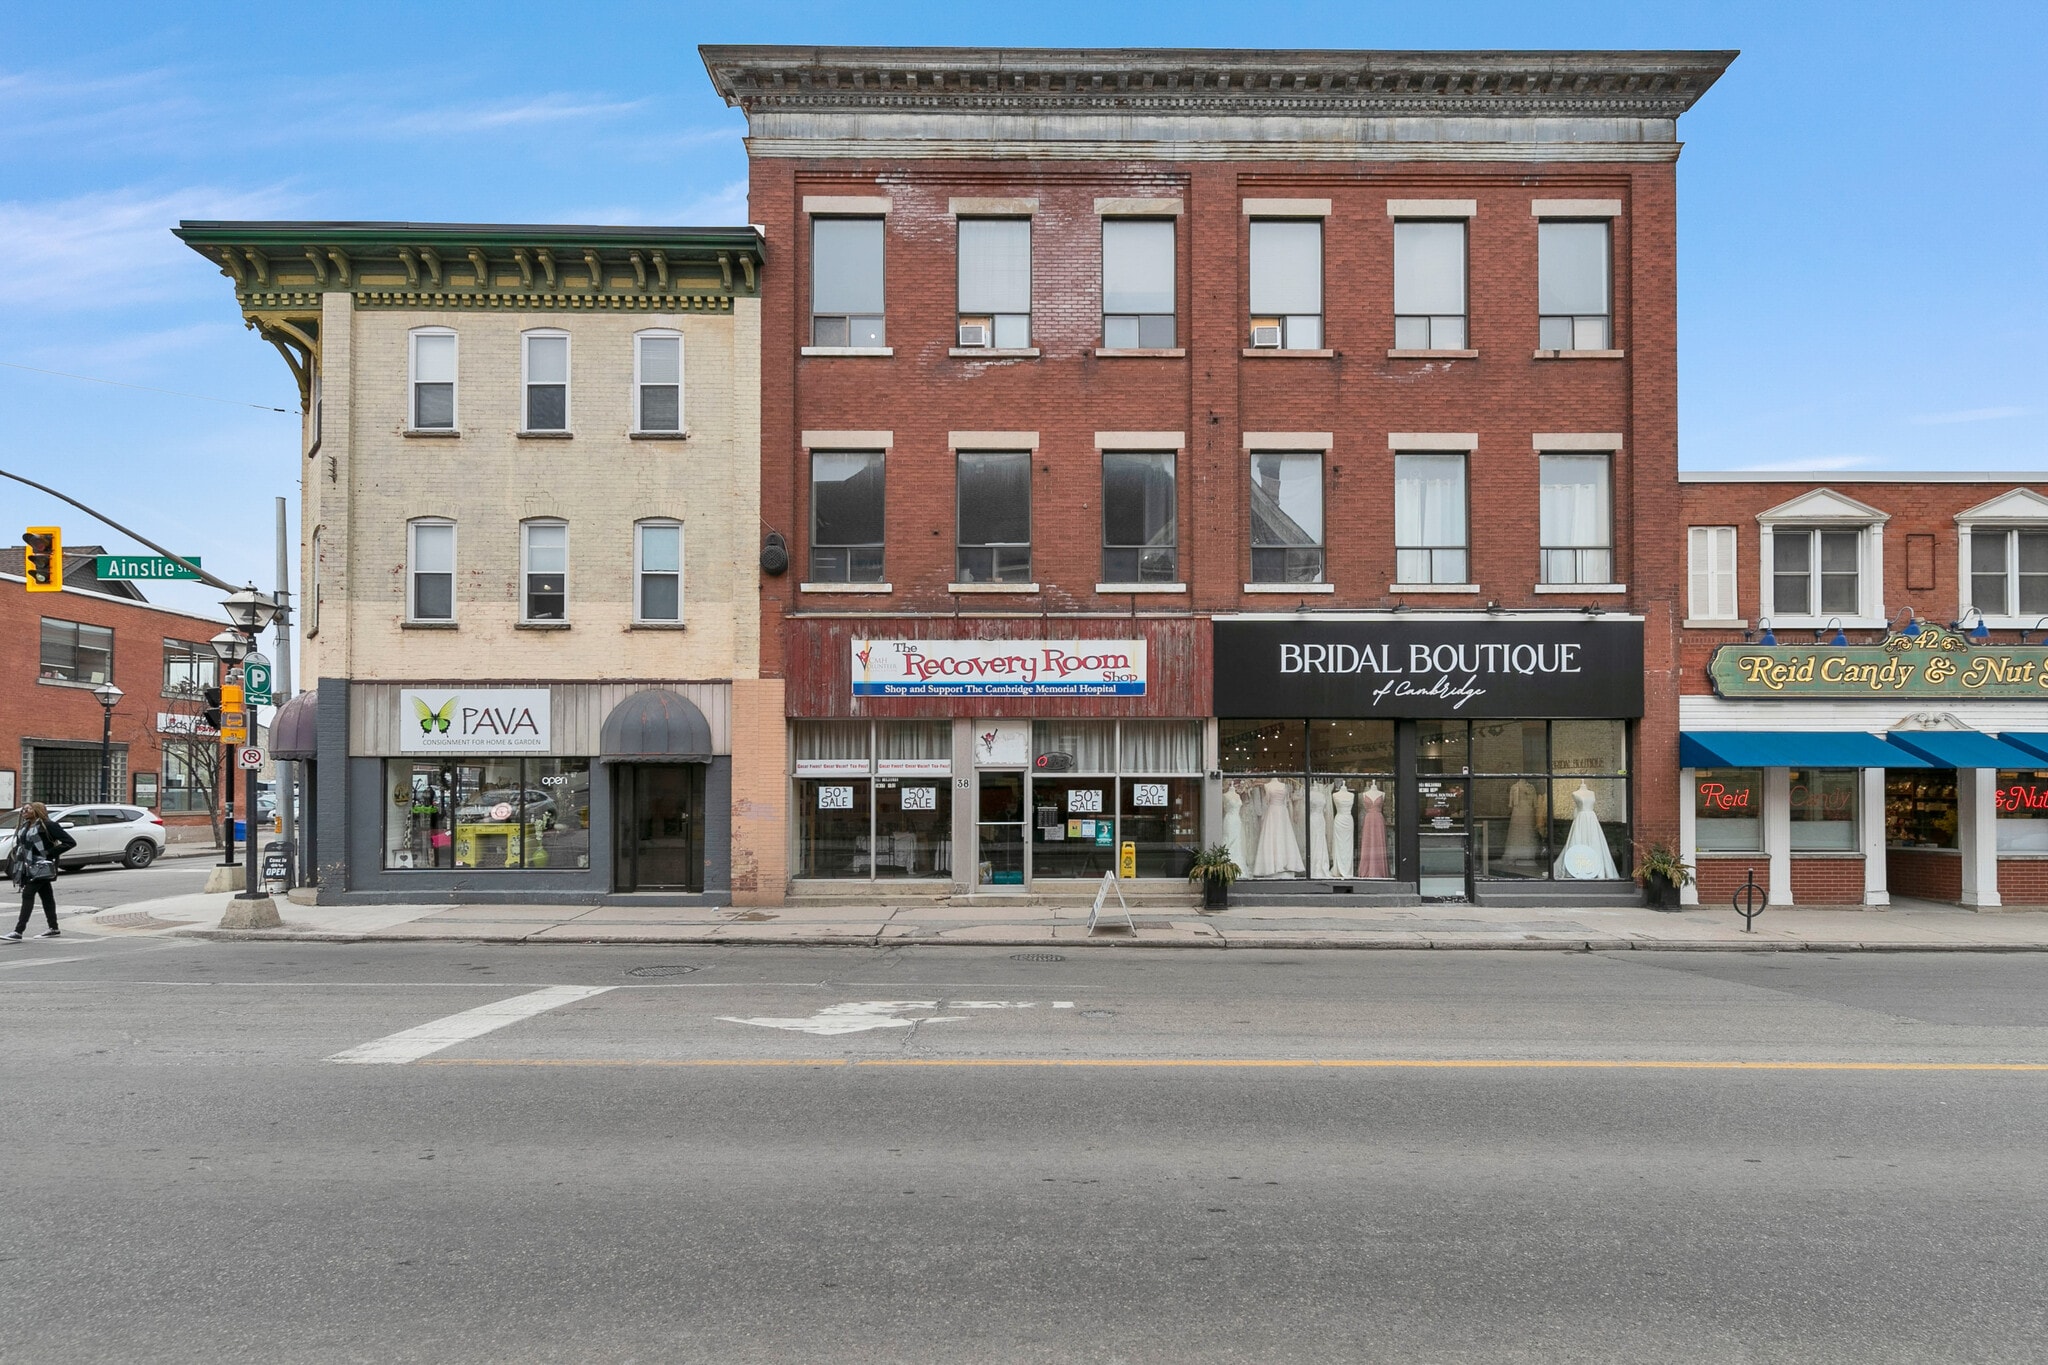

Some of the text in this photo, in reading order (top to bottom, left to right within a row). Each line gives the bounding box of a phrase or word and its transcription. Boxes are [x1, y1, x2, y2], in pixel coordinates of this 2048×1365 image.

[108, 559, 175, 577] Ainslie
[893, 643, 917, 652] The
[1914, 630, 1939, 650] 42
[902, 649, 1131, 683] Recovery Room
[1279, 643, 1582, 675] BRIDAL BOUTIQUE
[251, 669, 266, 688] P
[1102, 671, 1138, 683] Shop
[1738, 656, 1815, 690] Reid
[1821, 656, 1915, 690] Candy
[1925, 657, 1956, 683] &
[1962, 656, 2035, 689] Nut
[884, 685, 1117, 694] Shop and Support The Cambridge Memorial Hospital
[1373, 675, 1487, 710] of Cambridge
[462, 707, 539, 735] PAVA
[541, 776, 568, 787] open
[957, 779, 969, 788] 38
[821, 797, 848, 808] SALE
[904, 798, 932, 809] SALE
[1136, 796, 1163, 805] SALE
[1700, 783, 1750, 810] Reid
[1790, 785, 1852, 810] Candy
[1070, 801, 1098, 812] SALE
[266, 868, 287, 876] OPEN
